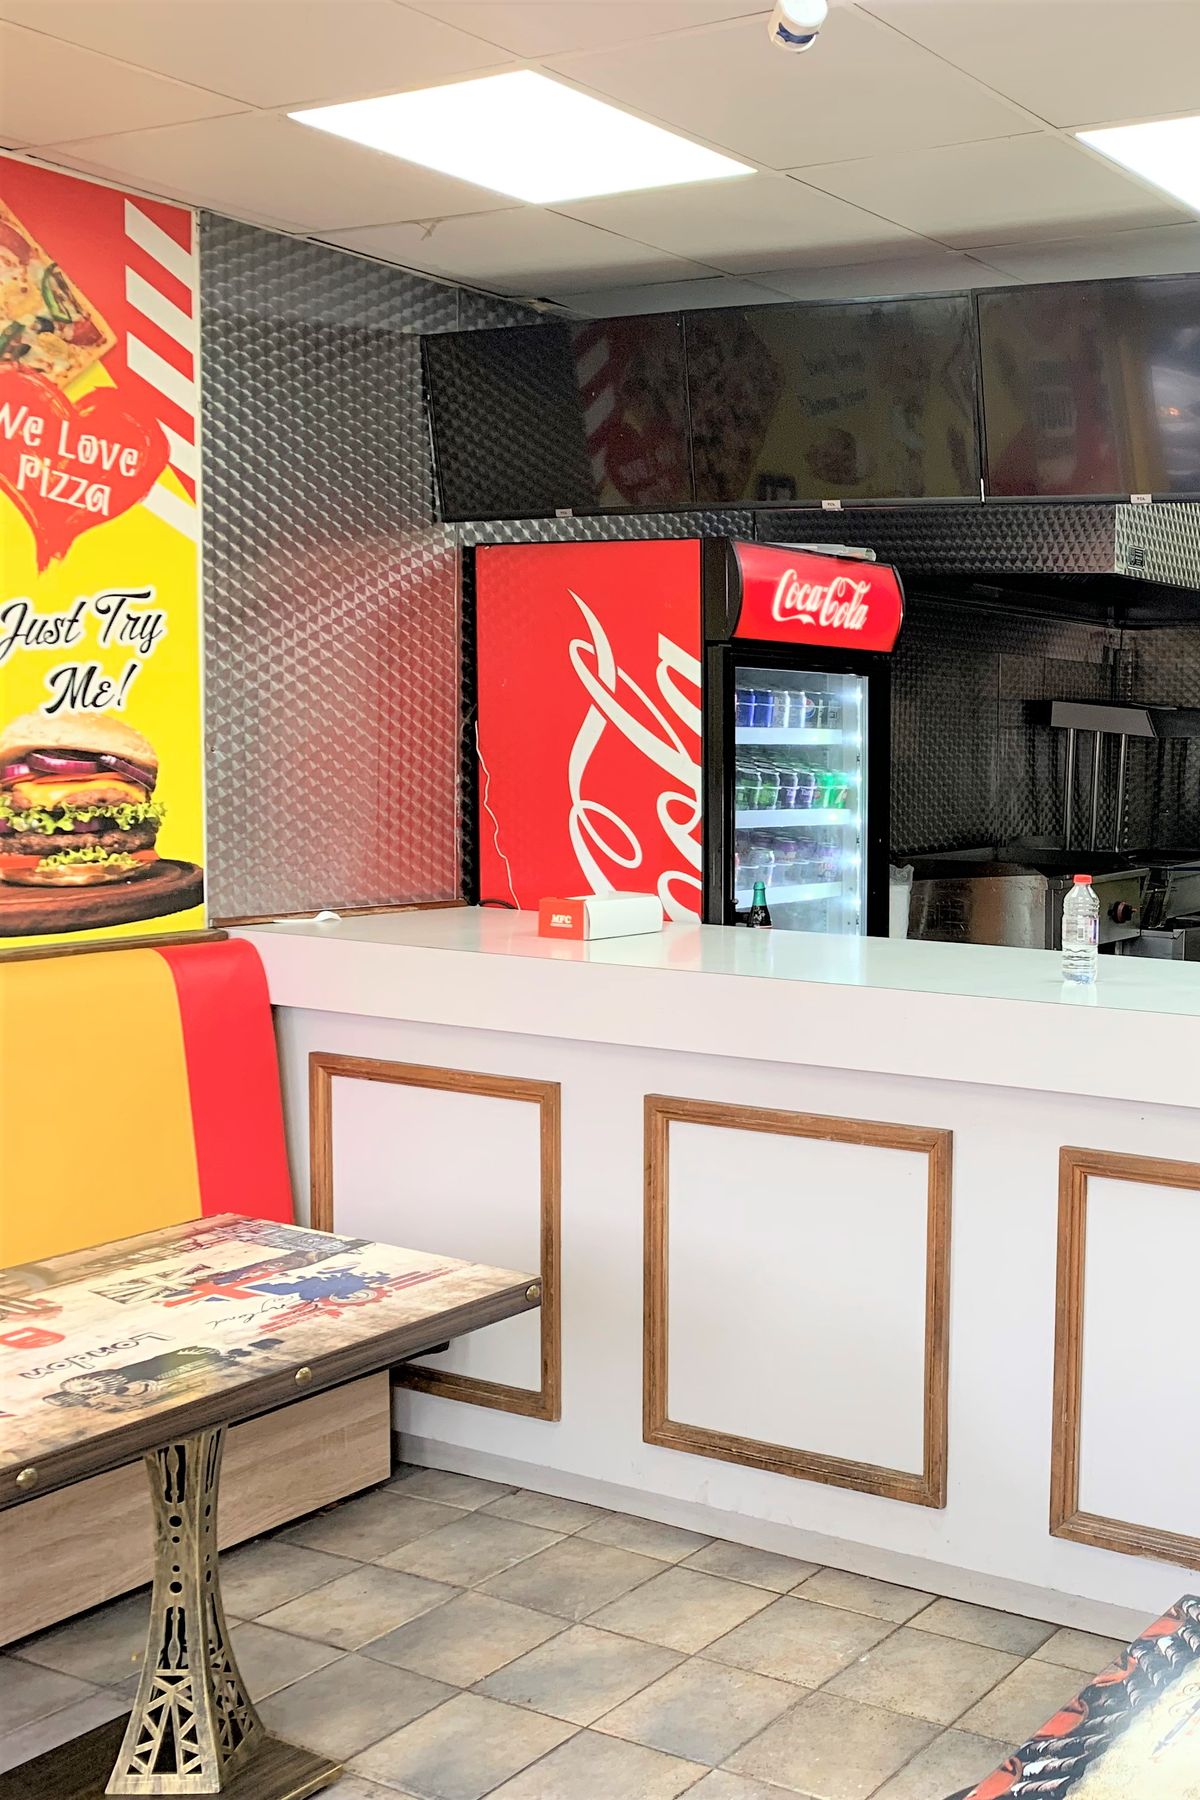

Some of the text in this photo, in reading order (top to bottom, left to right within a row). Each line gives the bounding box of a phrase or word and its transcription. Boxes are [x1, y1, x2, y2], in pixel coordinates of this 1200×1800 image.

[0, 401, 139, 477] We Love
[0, 590, 164, 658] Just Try
[771, 568, 872, 630] Coca-Cola
[45, 663, 138, 714] Me!
[551, 914, 572, 924] MFC
[17, 1331, 176, 1380] London
